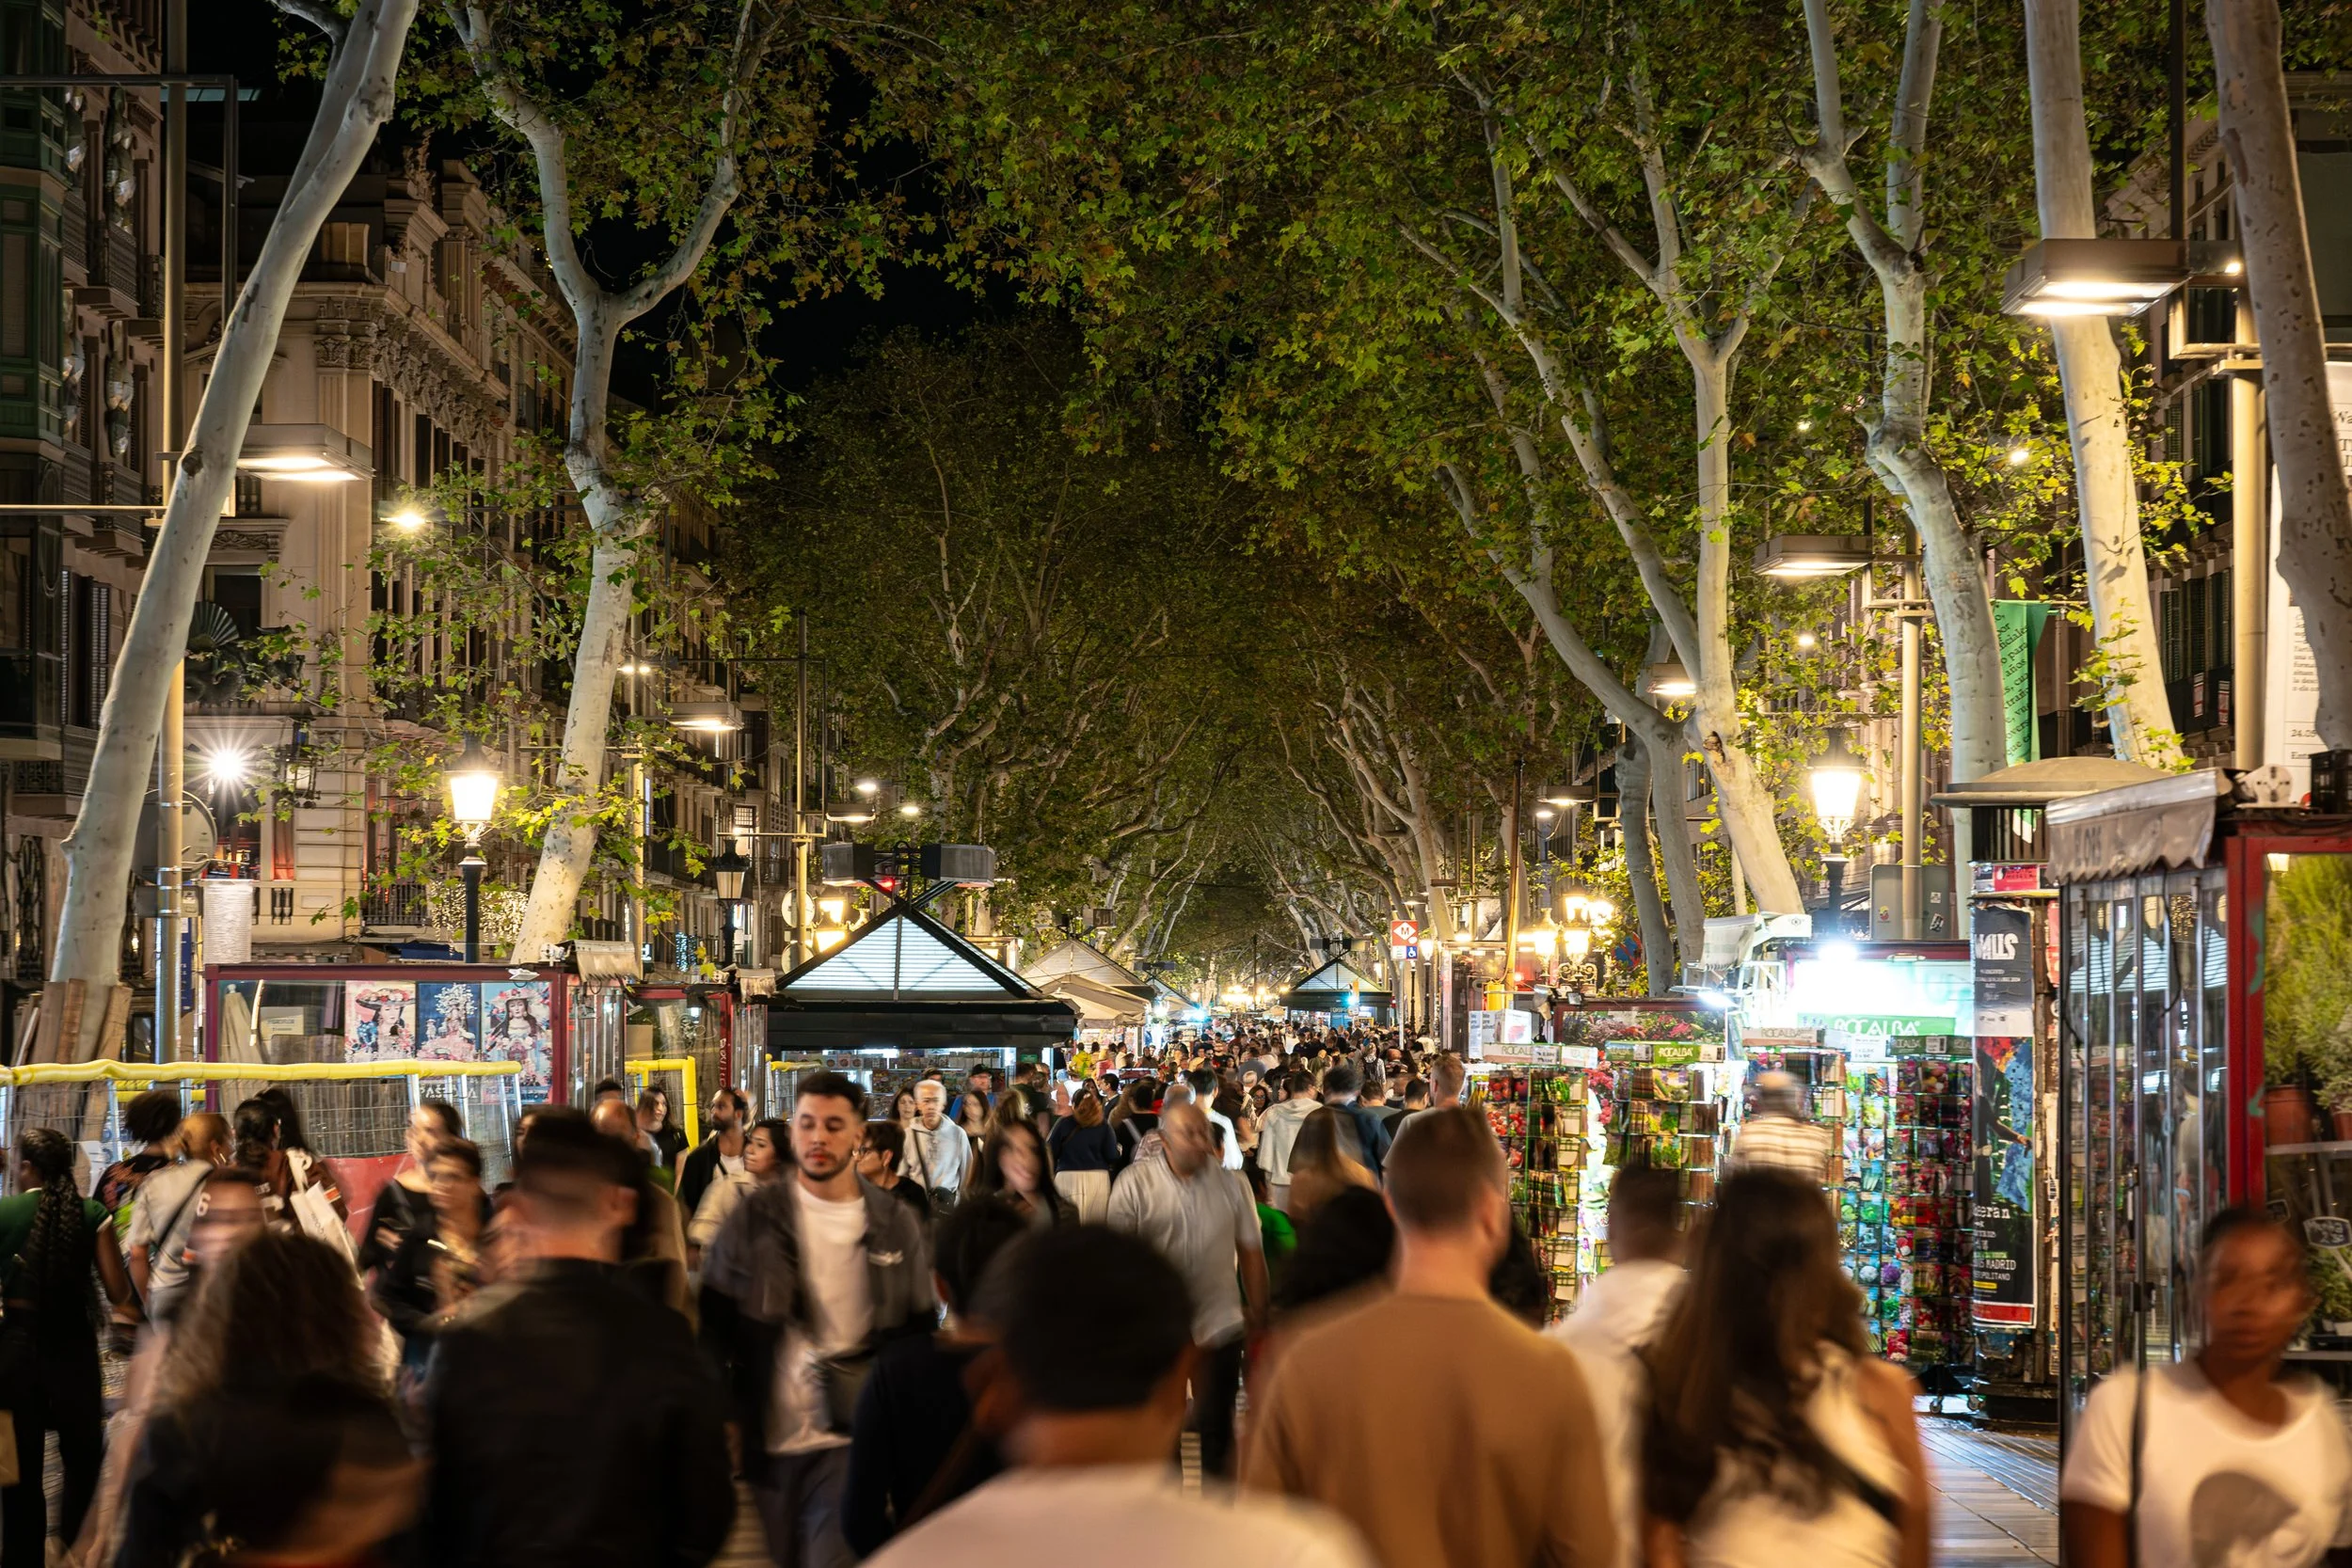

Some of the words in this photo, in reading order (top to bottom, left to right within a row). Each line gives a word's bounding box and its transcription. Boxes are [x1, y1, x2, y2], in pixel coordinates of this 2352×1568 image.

[1401, 927, 1409, 936] M
[1761, 1027, 1802, 1037] ROCALBA
[1834, 1019, 1918, 1036] ROCALBA
[1659, 1046, 1692, 1057] ROCALBA
[196, 1192, 212, 1217] 6
[1986, 1259, 2017, 1271] MADRID
